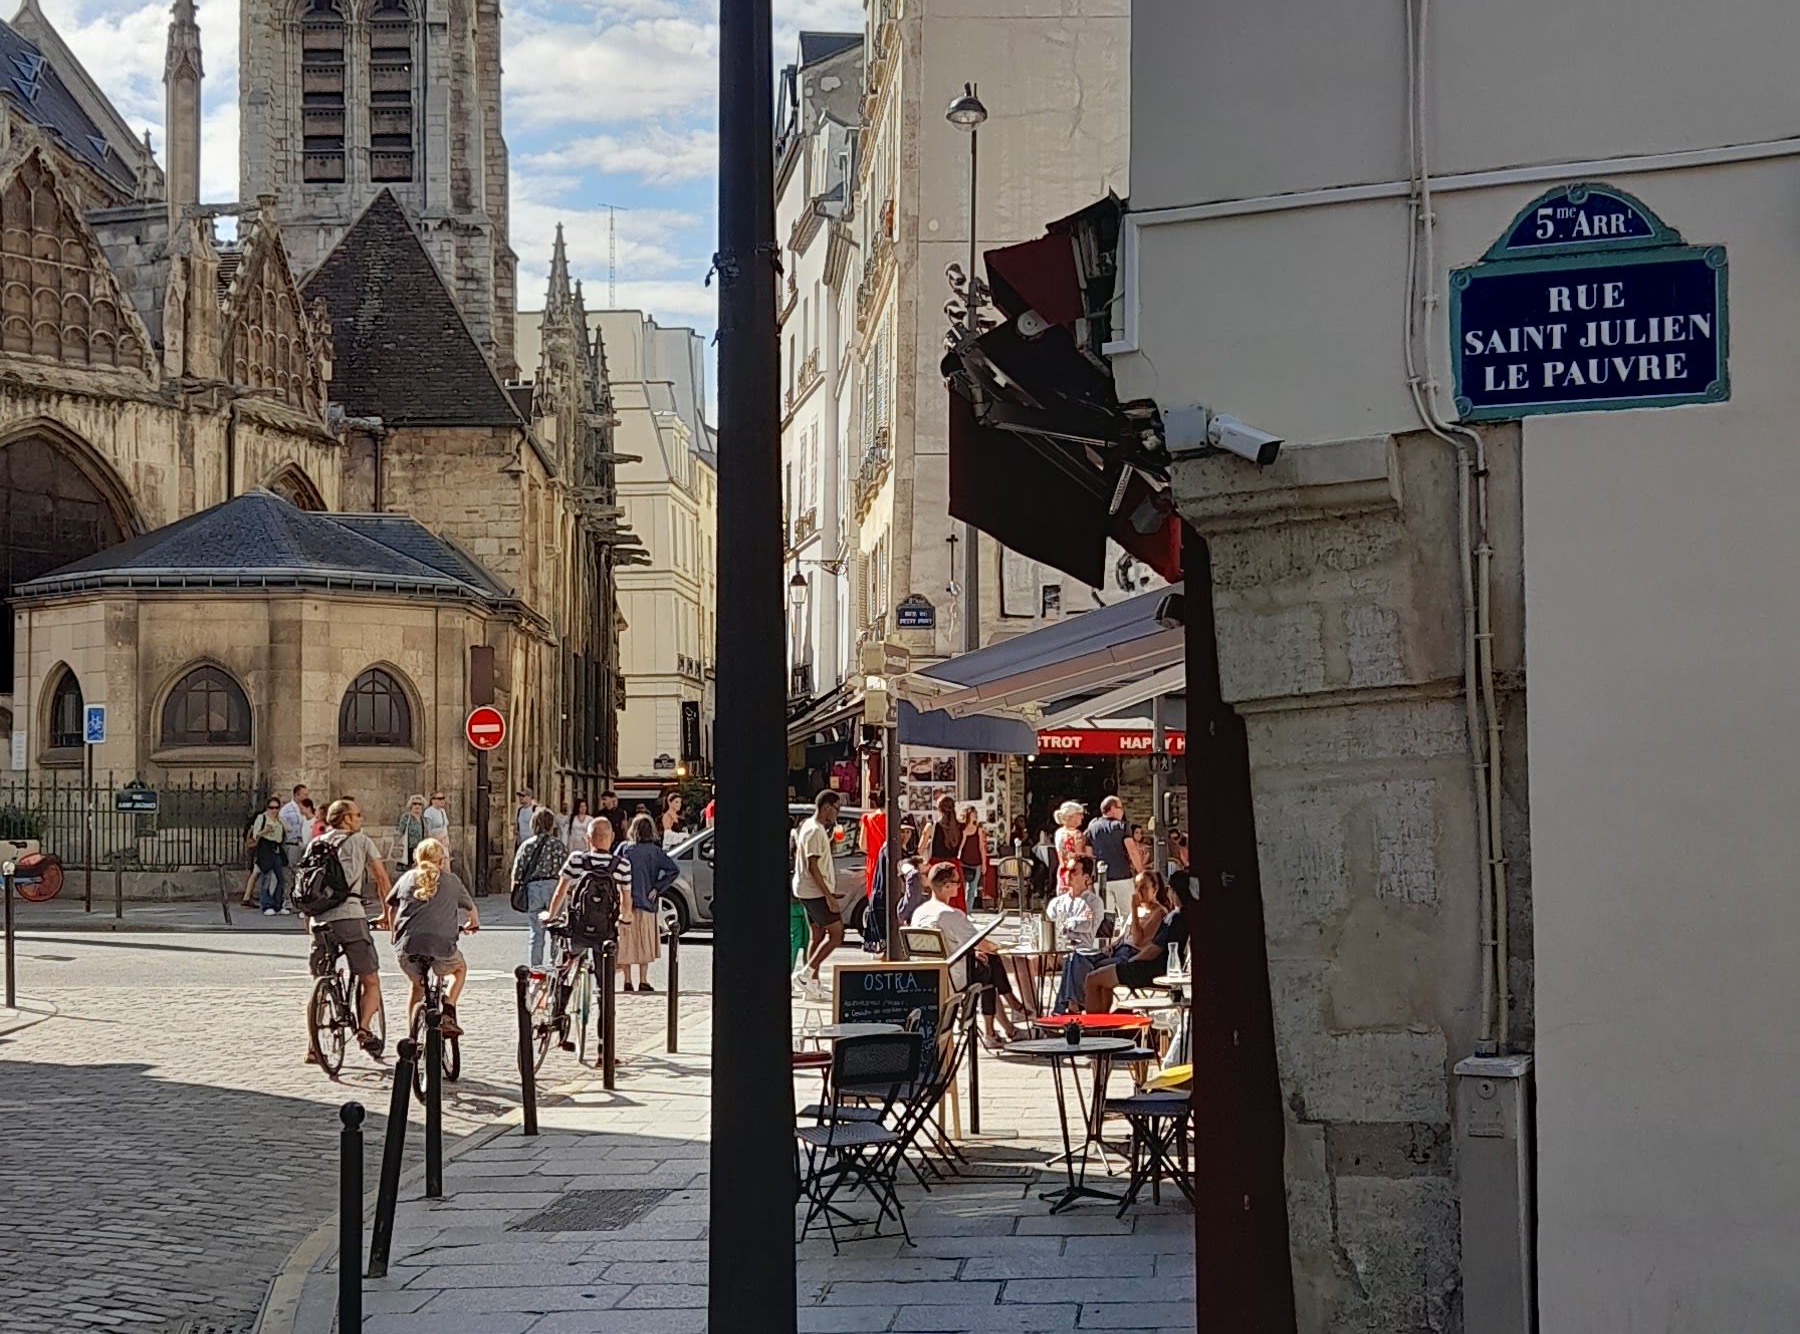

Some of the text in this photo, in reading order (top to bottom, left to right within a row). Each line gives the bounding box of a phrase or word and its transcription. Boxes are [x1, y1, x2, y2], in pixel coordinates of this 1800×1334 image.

[1548, 282, 1625, 313] RUE
[1465, 313, 1711, 355] SAINT JULIEN
[1484, 353, 1688, 391] LE PAUVRE
[1120, 737, 1173, 750] HAPY
[864, 972, 917, 991] OSTRA
